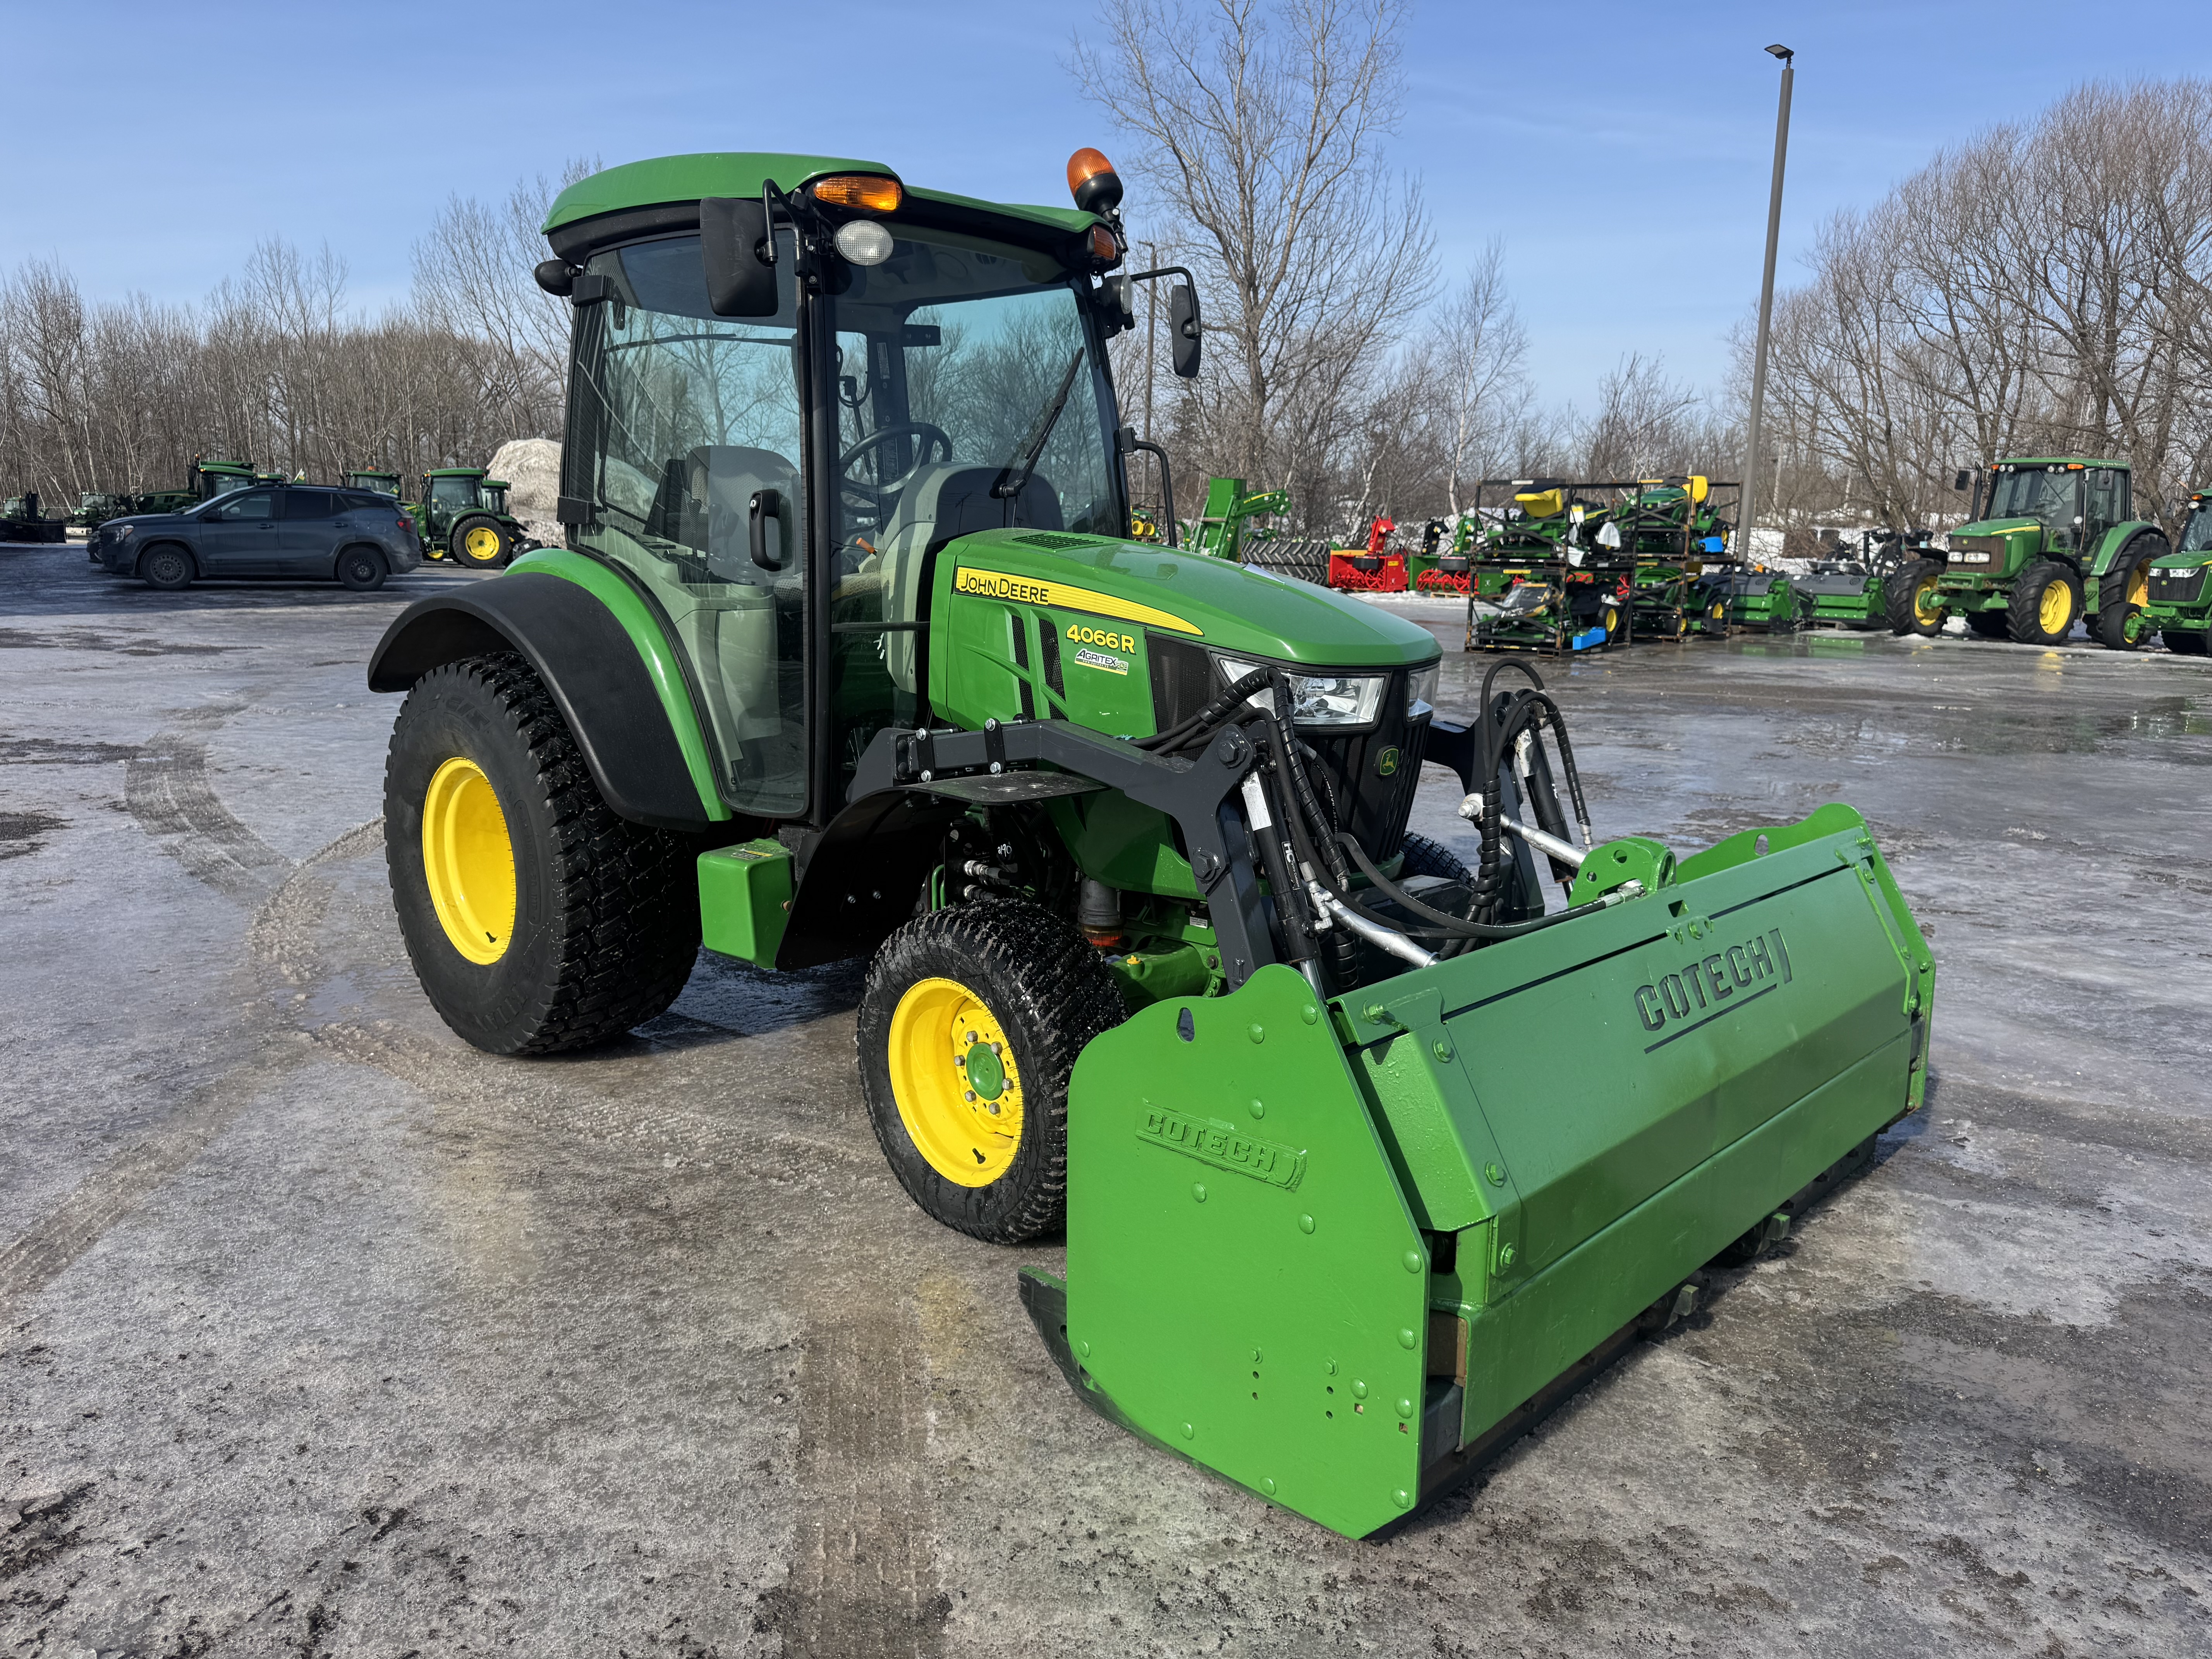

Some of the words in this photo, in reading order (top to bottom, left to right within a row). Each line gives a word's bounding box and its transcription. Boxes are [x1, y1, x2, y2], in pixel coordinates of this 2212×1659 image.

[961, 573, 996, 594] JOHN
[999, 578, 1049, 603] DEERE
[1077, 650, 1116, 666] AGRITEX
[1634, 936, 1774, 1031] COTECH
[1142, 1110, 1276, 1172] COTECH
